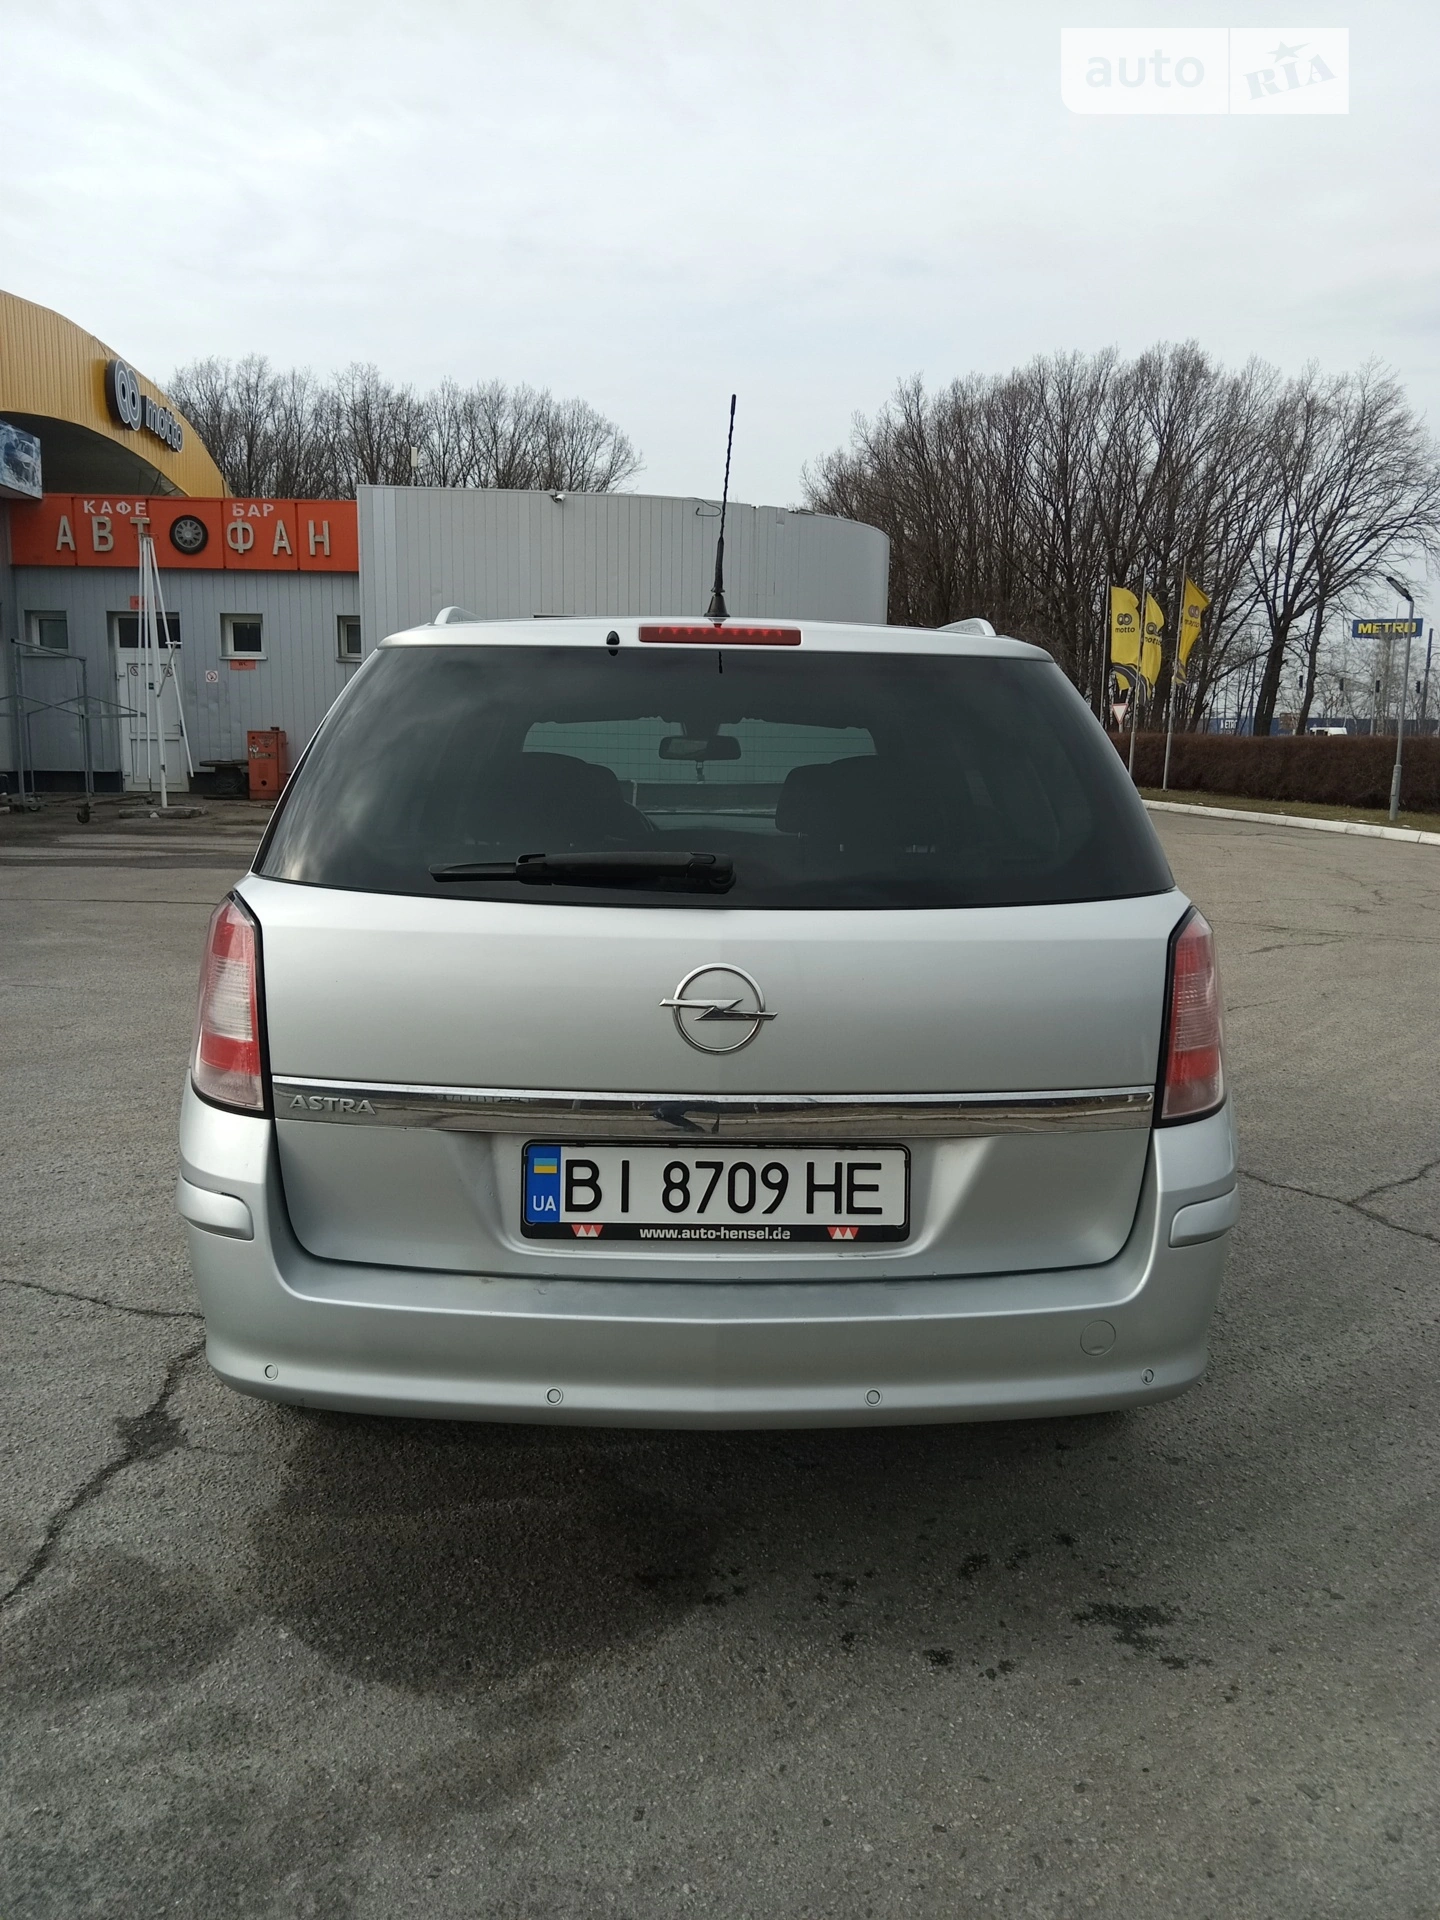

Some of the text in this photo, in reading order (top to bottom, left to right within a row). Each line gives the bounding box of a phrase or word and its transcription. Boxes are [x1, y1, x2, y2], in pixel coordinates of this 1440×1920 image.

[145, 395, 184, 453] motto
[83, 500, 275, 517] КАФЕ БАР
[1357, 622, 1417, 634] METRO
[289, 1094, 376, 1115] ASTRA
[564, 1159, 883, 1215] BI 8709 HE
[533, 1196, 557, 1212] UA
[639, 1227, 792, 1241] www.auto-hensel.de
